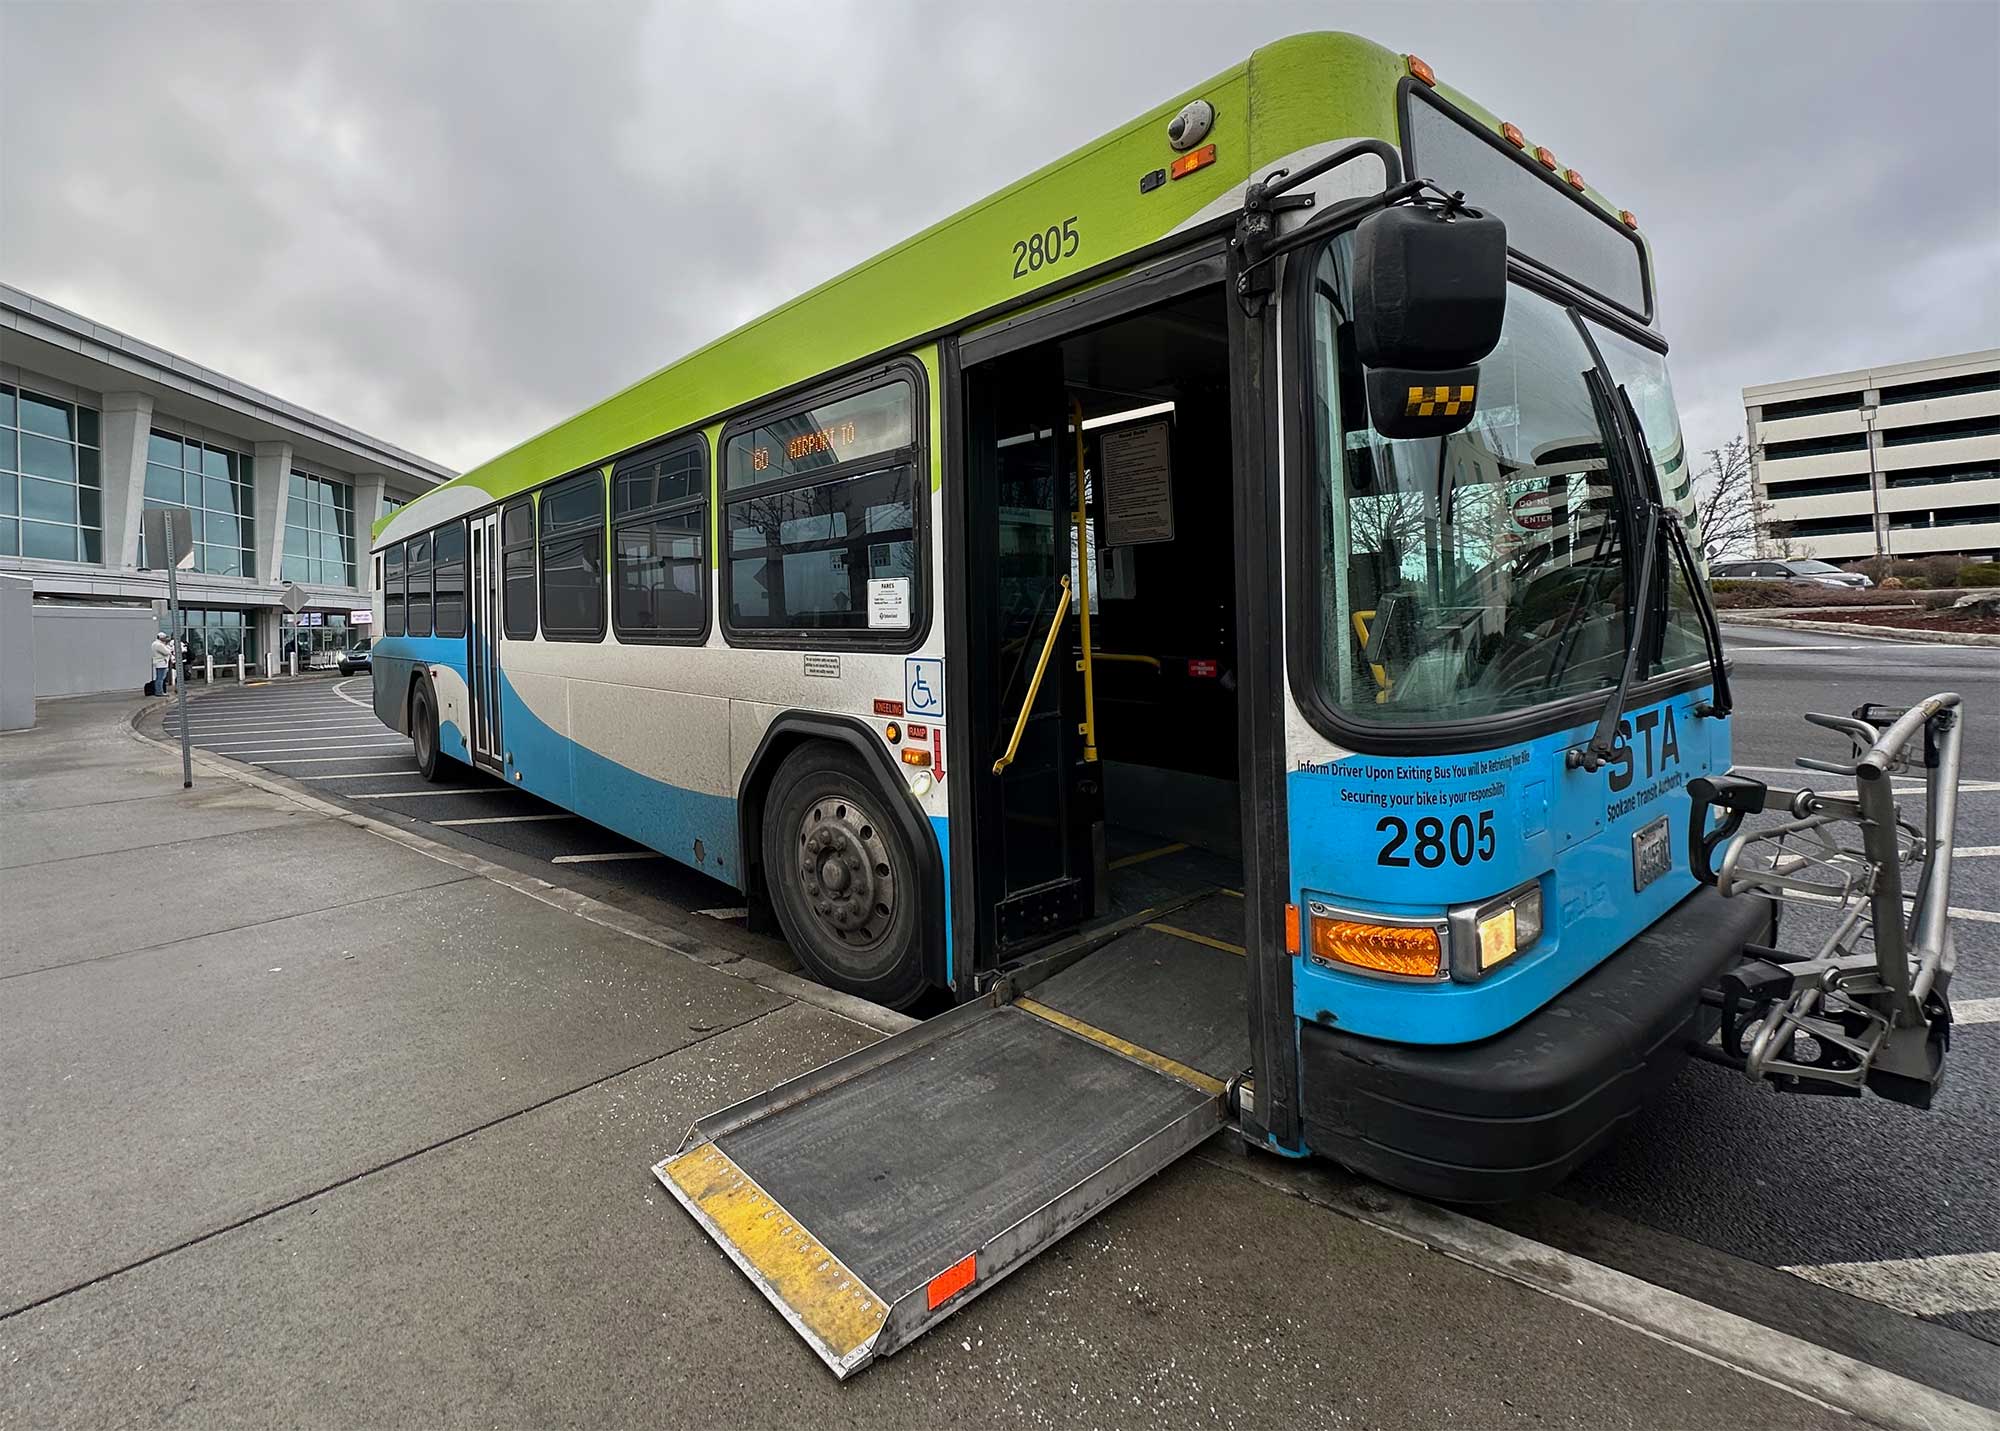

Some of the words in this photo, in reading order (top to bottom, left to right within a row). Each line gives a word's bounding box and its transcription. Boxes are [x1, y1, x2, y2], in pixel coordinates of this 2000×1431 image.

[1012, 216, 1080, 279] 2805
[790, 428, 834, 460] AIRPORT
[842, 422, 855, 446] TO
[1520, 500, 1533, 508] DO
[1524, 514, 1553, 524] ENTER
[876, 702, 902, 715] KNEELING
[908, 726, 926, 737] RAMP
[1608, 705, 1680, 793] STA
[1297, 760, 1329, 775] Inform
[1332, 763, 1363, 777] Driver
[1365, 766, 1394, 782] Upon
[1397, 765, 1432, 783] Exiting
[1434, 766, 1451, 779] Bus
[1452, 765, 1467, 777] You
[1467, 762, 1480, 776] will
[1481, 761, 1488, 774] be
[1489, 756, 1512, 771] Retrieving
[1512, 754, 1521, 766] Your
[1521, 750, 1530, 763] Bike
[1341, 788, 1387, 808] Securing
[1389, 794, 1414, 808] your
[1416, 792, 1438, 805] bike
[1440, 790, 1447, 804] is
[1449, 793, 1467, 807] your
[1468, 781, 1506, 802] responsibility
[1607, 796, 1636, 823] Spokane
[1636, 783, 1658, 808] Transit
[1659, 771, 1682, 795] Authority
[1375, 809, 1496, 868] 2805
